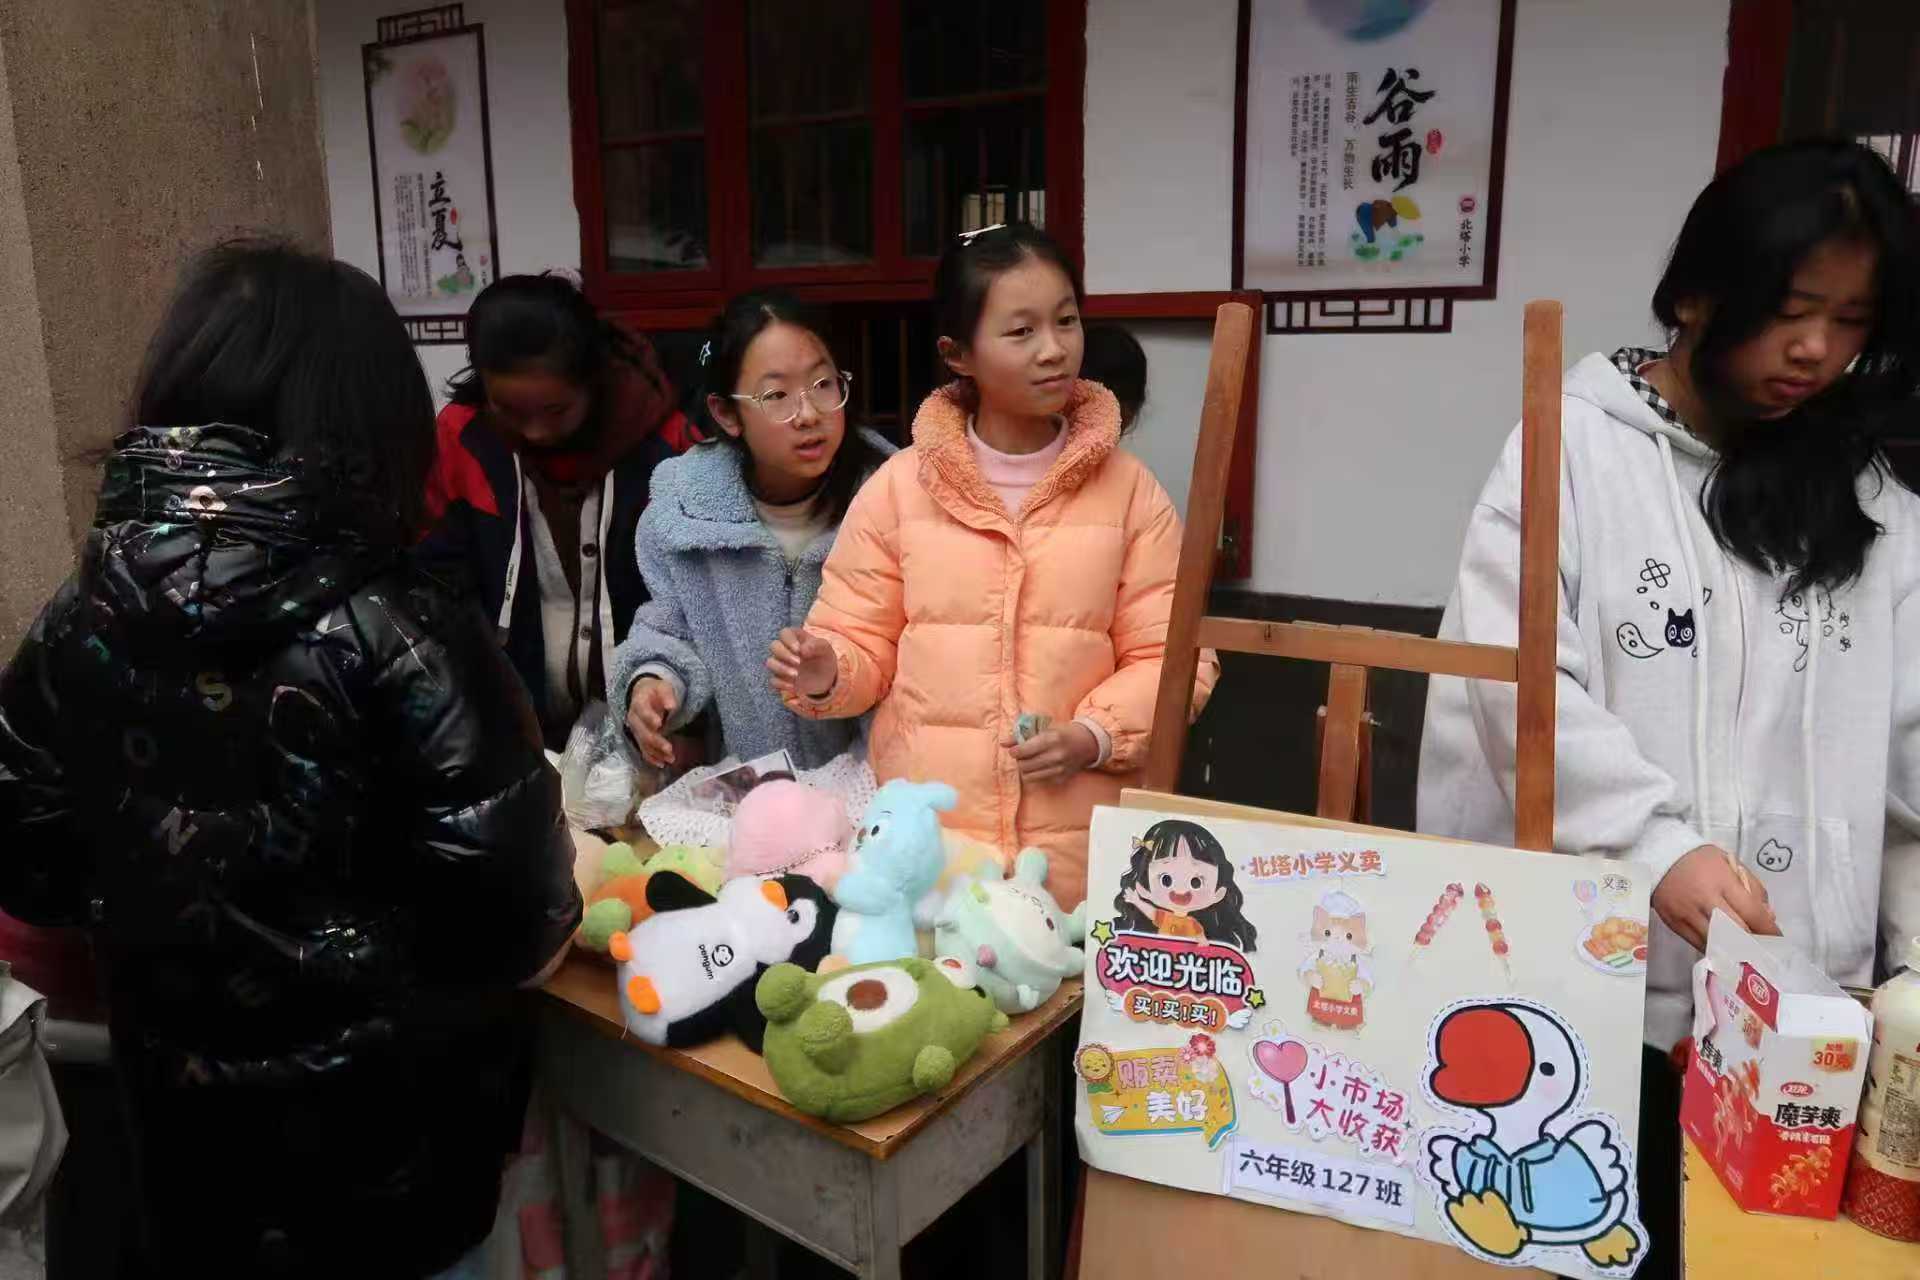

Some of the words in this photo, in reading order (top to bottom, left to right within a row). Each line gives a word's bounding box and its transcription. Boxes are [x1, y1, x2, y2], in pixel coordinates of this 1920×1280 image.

[1362, 67, 1437, 192] 谷雨
[428, 171, 463, 252] 立夏
[1458, 218, 1473, 268] 北塔小学
[1249, 850, 1383, 877] 北塔小学义卖
[1104, 946, 1244, 997] 欢迎光临
[1117, 1056, 1180, 1090] 贩卖
[1309, 1063, 1404, 1122] 小市场
[1147, 1089, 1208, 1123] 美好
[1306, 1098, 1404, 1157] 大收获
[1774, 1102, 1841, 1129] 魔芋爽
